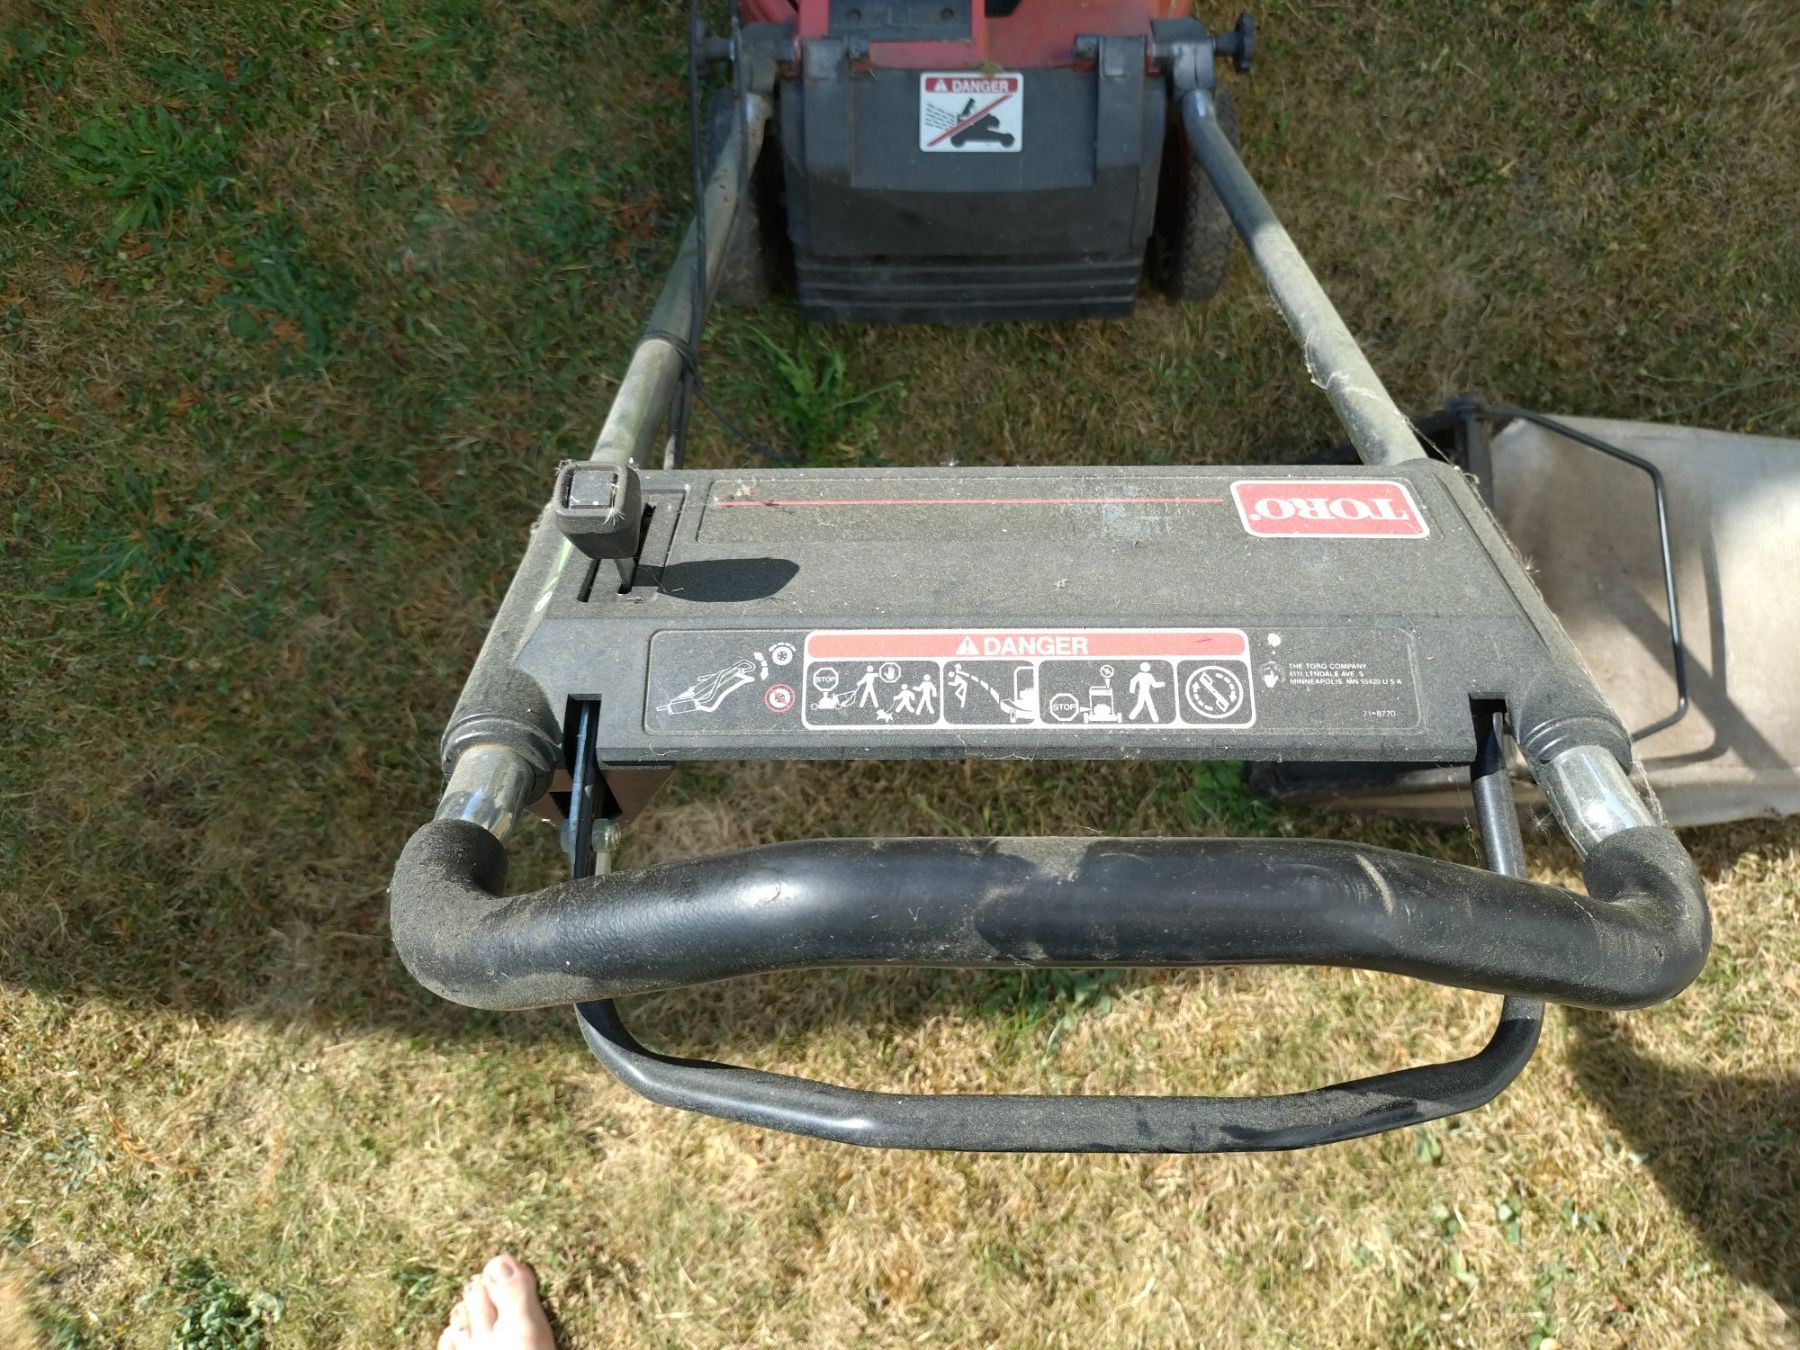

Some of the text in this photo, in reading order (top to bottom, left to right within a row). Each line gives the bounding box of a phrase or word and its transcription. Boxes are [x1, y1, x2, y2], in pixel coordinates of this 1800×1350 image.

[953, 79, 1009, 93] DANGER
[1254, 497, 1408, 521] TORO
[983, 636, 1089, 656] DANGER
[1052, 703, 1076, 711] STOP
